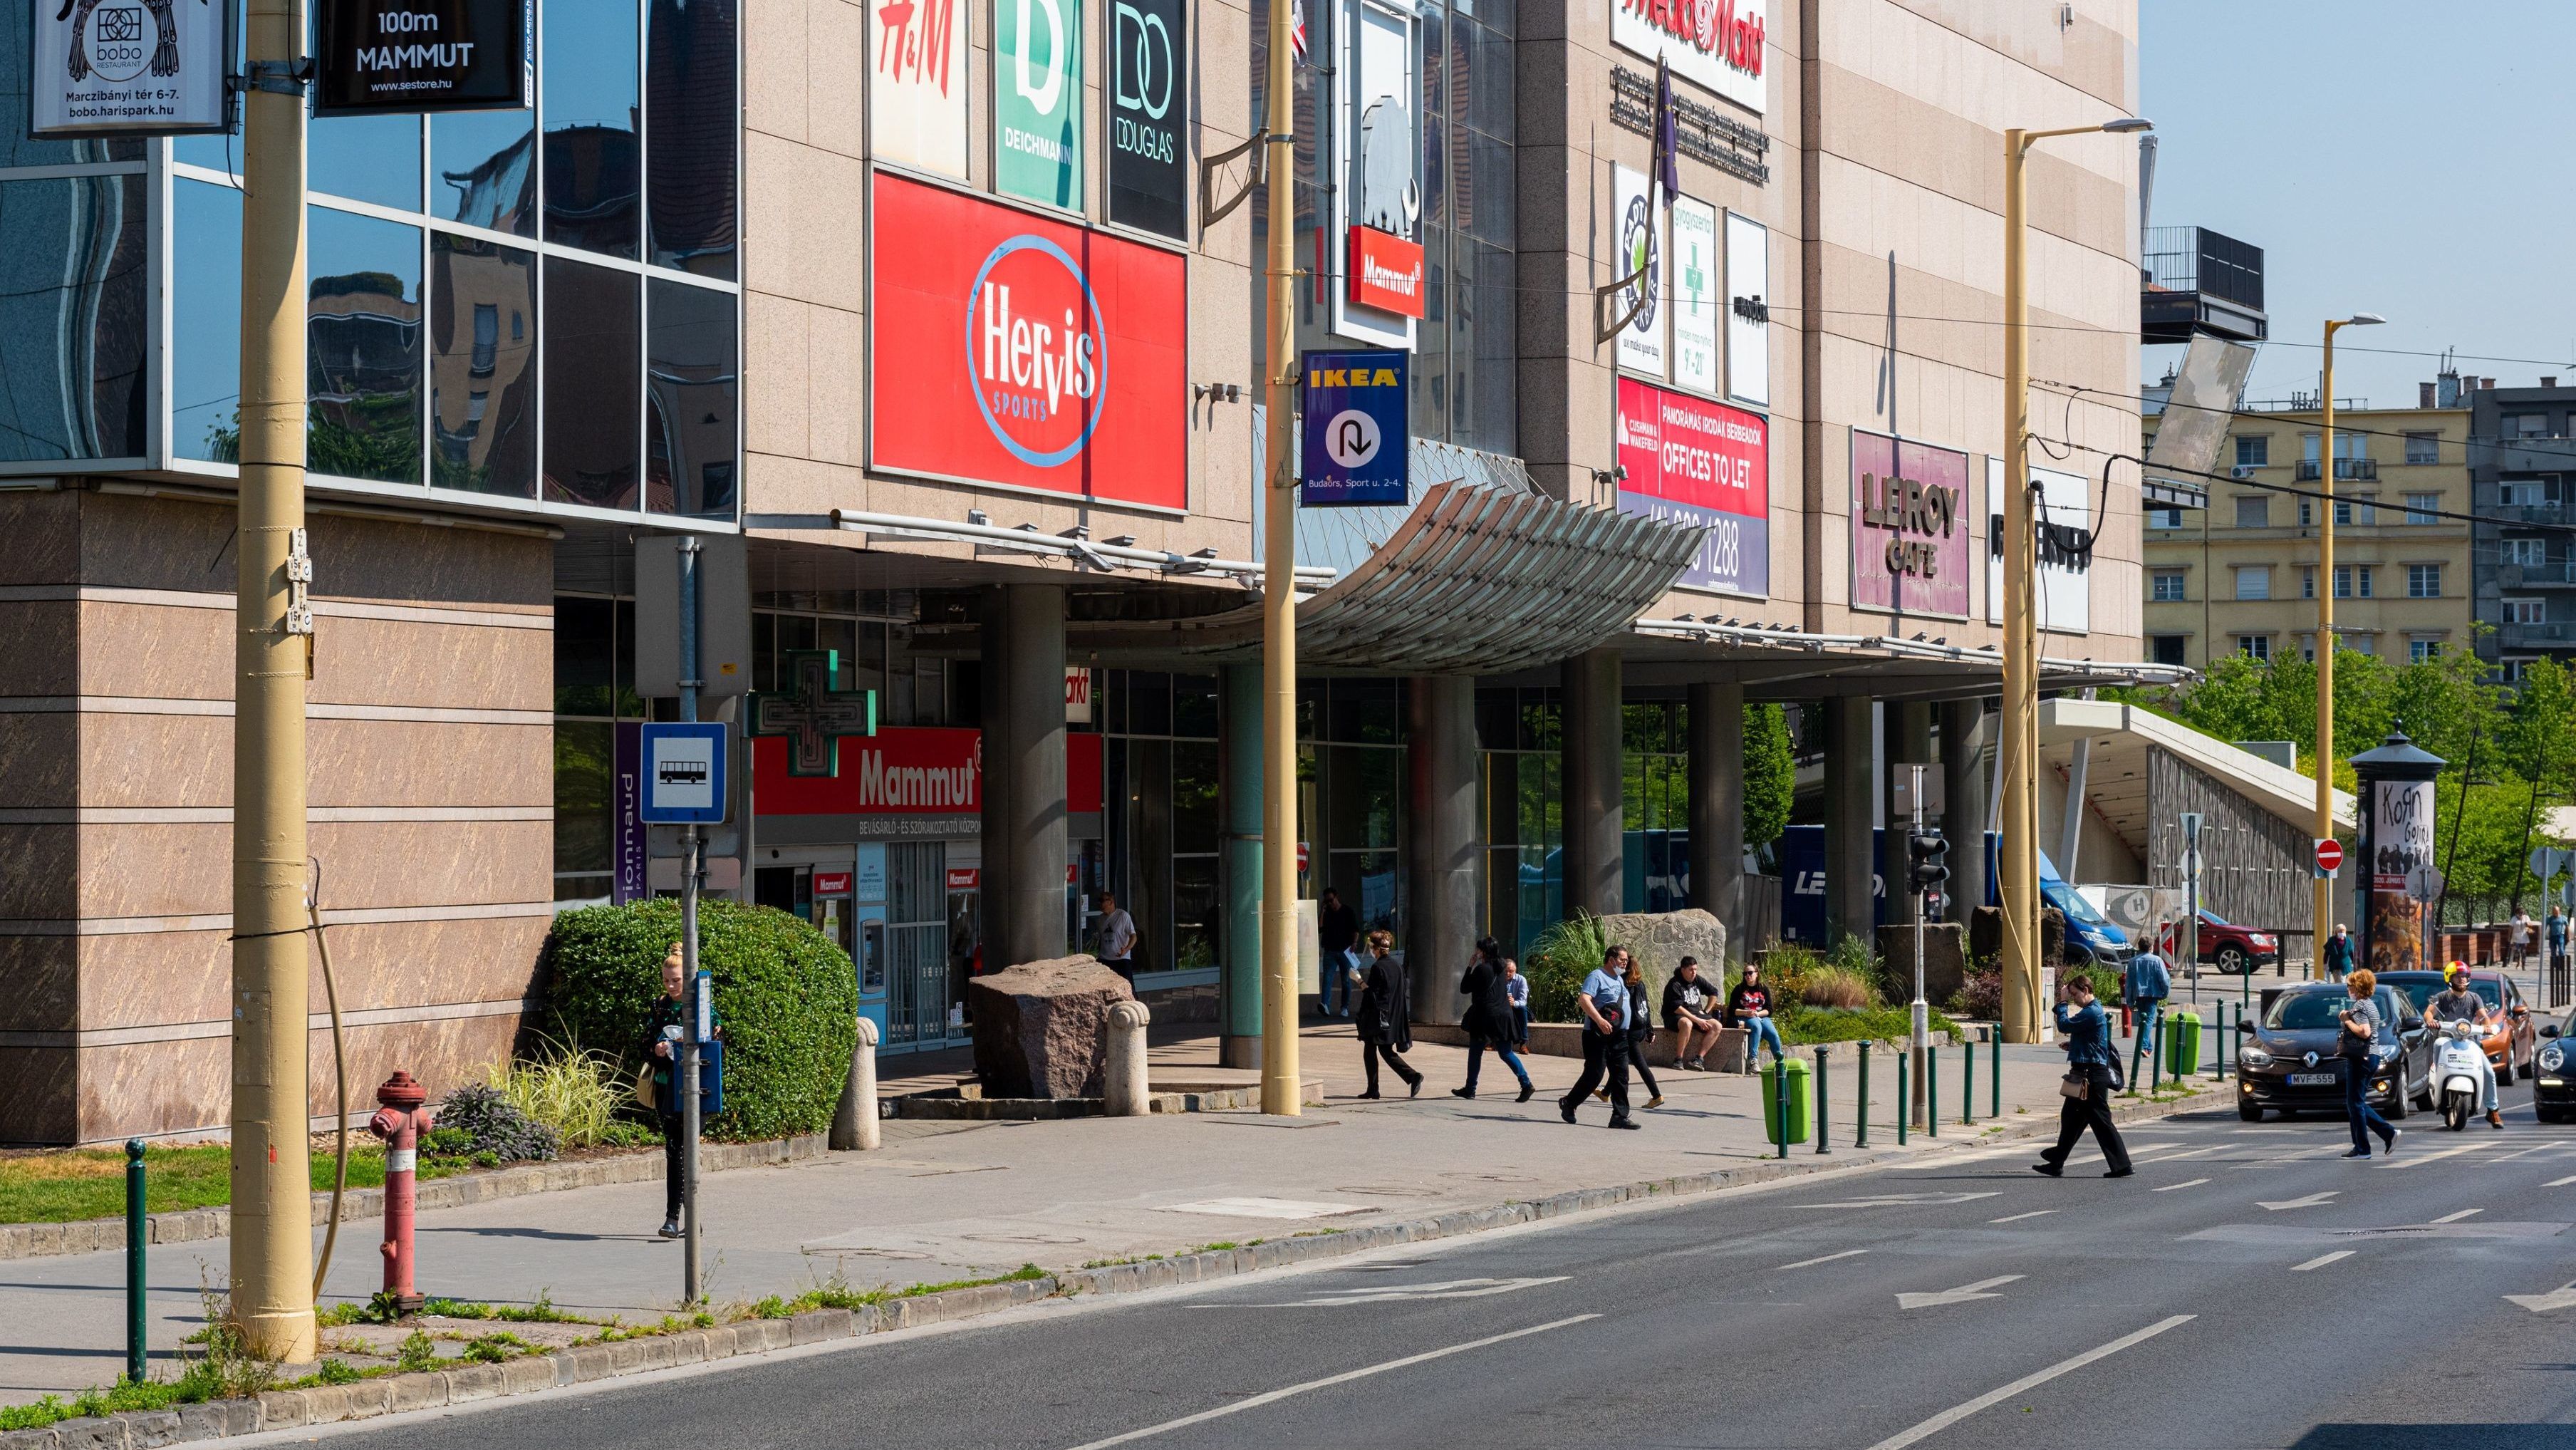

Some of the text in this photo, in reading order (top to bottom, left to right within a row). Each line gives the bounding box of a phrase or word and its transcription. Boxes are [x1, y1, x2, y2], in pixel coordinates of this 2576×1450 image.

[378, 11, 438, 33] 100m
[97, 43, 142, 61] bobo
[357, 43, 474, 72] MAMMUT
[66, 89, 180, 103] Marczibányi tér 6-7.
[371, 79, 452, 91] www.sestore.hu
[69, 105, 174, 118] bobo.harispark.hu
[1005, 127, 1072, 166] DEICHMANN
[1117, 116, 1173, 165] DOUGLAS
[1364, 254, 1416, 297] Mammut
[984, 281, 1096, 415] Hervis
[1311, 368, 1398, 388] IKEA
[993, 390, 1047, 422] SPORTS
[1629, 419, 1653, 435] CUSHMAN
[1662, 405, 1762, 447] PANORÁMÁS IRODÁK BÉRBEADÓK
[1629, 435, 1658, 452] WAKEFIELD
[1663, 440, 1750, 490] OFFICES TO LET
[1346, 478, 1369, 488] Sport
[1383, 478, 1401, 487] 2-4.
[1863, 472, 1960, 537] LEROY
[1886, 538, 1938, 575] CAFE
[860, 749, 975, 807] Mammut
[859, 817, 896, 835] BEVÁSÁRLÓ
[901, 817, 909, 834] ÉS
[910, 817, 957, 834] SZÓRAKOZTATÓ
[820, 879, 844, 891] Mammut
[950, 871, 974, 885] Mammut
